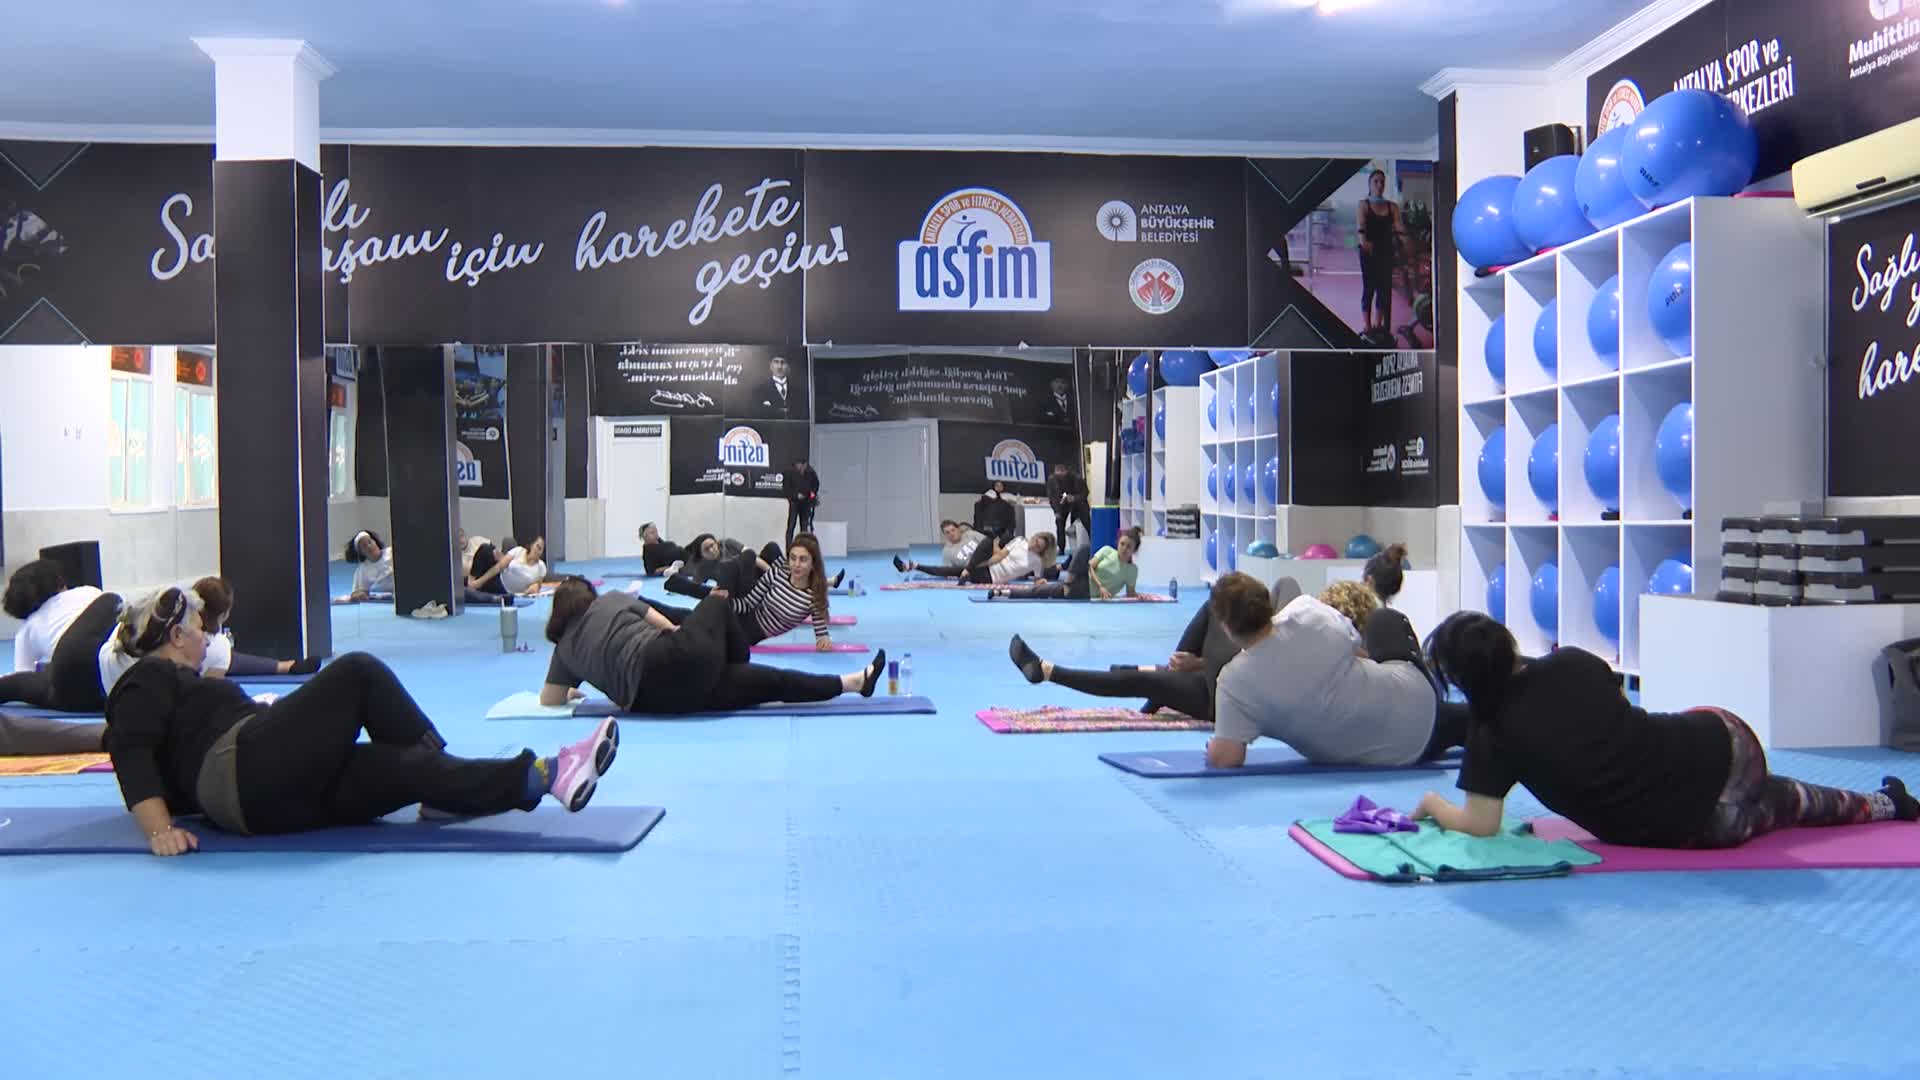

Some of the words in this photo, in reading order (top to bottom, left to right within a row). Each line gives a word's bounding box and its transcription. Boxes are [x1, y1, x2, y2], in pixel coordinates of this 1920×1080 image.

[1726, 39, 1760, 85] SPOR
[1762, 38, 1780, 66] ve
[1849, 16, 1920, 64] Muhittin
[1849, 61, 1877, 80] Antalya
[446, 233, 544, 287] için
[575, 177, 801, 272] harekete
[1140, 204, 1190, 215] ANTALYA
[1140, 216, 1215, 231] BÜYÜKŞEHİR
[1140, 231, 1199, 243] BELEDİYESİ
[688, 225, 849, 326] geçin!
[915, 229, 1037, 309] asfim
[1852, 233, 1920, 312] Sağlı
